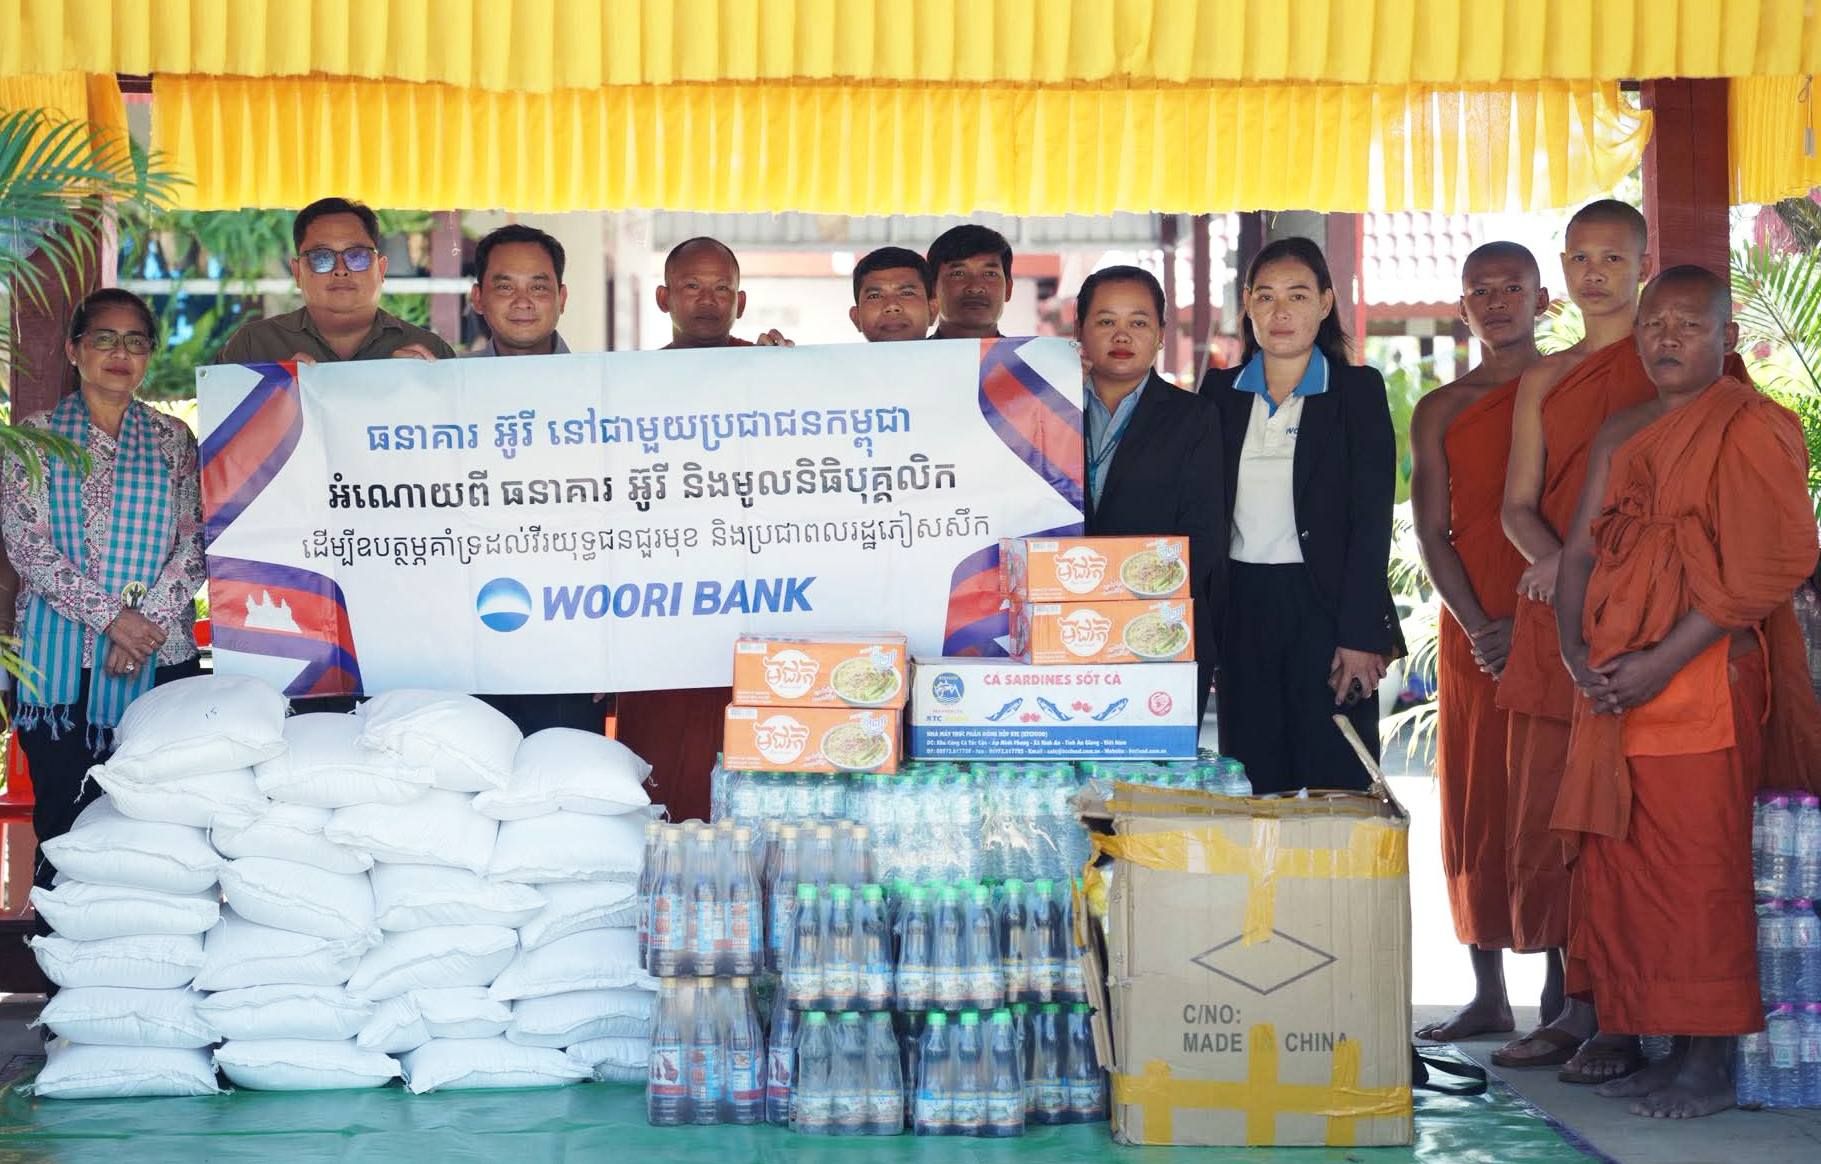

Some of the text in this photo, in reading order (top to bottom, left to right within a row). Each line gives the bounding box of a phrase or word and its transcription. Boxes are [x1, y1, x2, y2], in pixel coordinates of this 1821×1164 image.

[367, 423, 479, 451] ធនាគារ
[328, 469, 489, 509] អំណោយពី
[501, 476, 612, 506] ធនាគារ
[682, 453, 956, 509] និងមូលនិធិបុគ្គលិក
[543, 575, 817, 621] WOORI BANK
[1005, 673, 1072, 686] SARDINES
[1183, 1004, 1241, 1024] C/NO:
[1183, 1033, 1242, 1052] MADE
